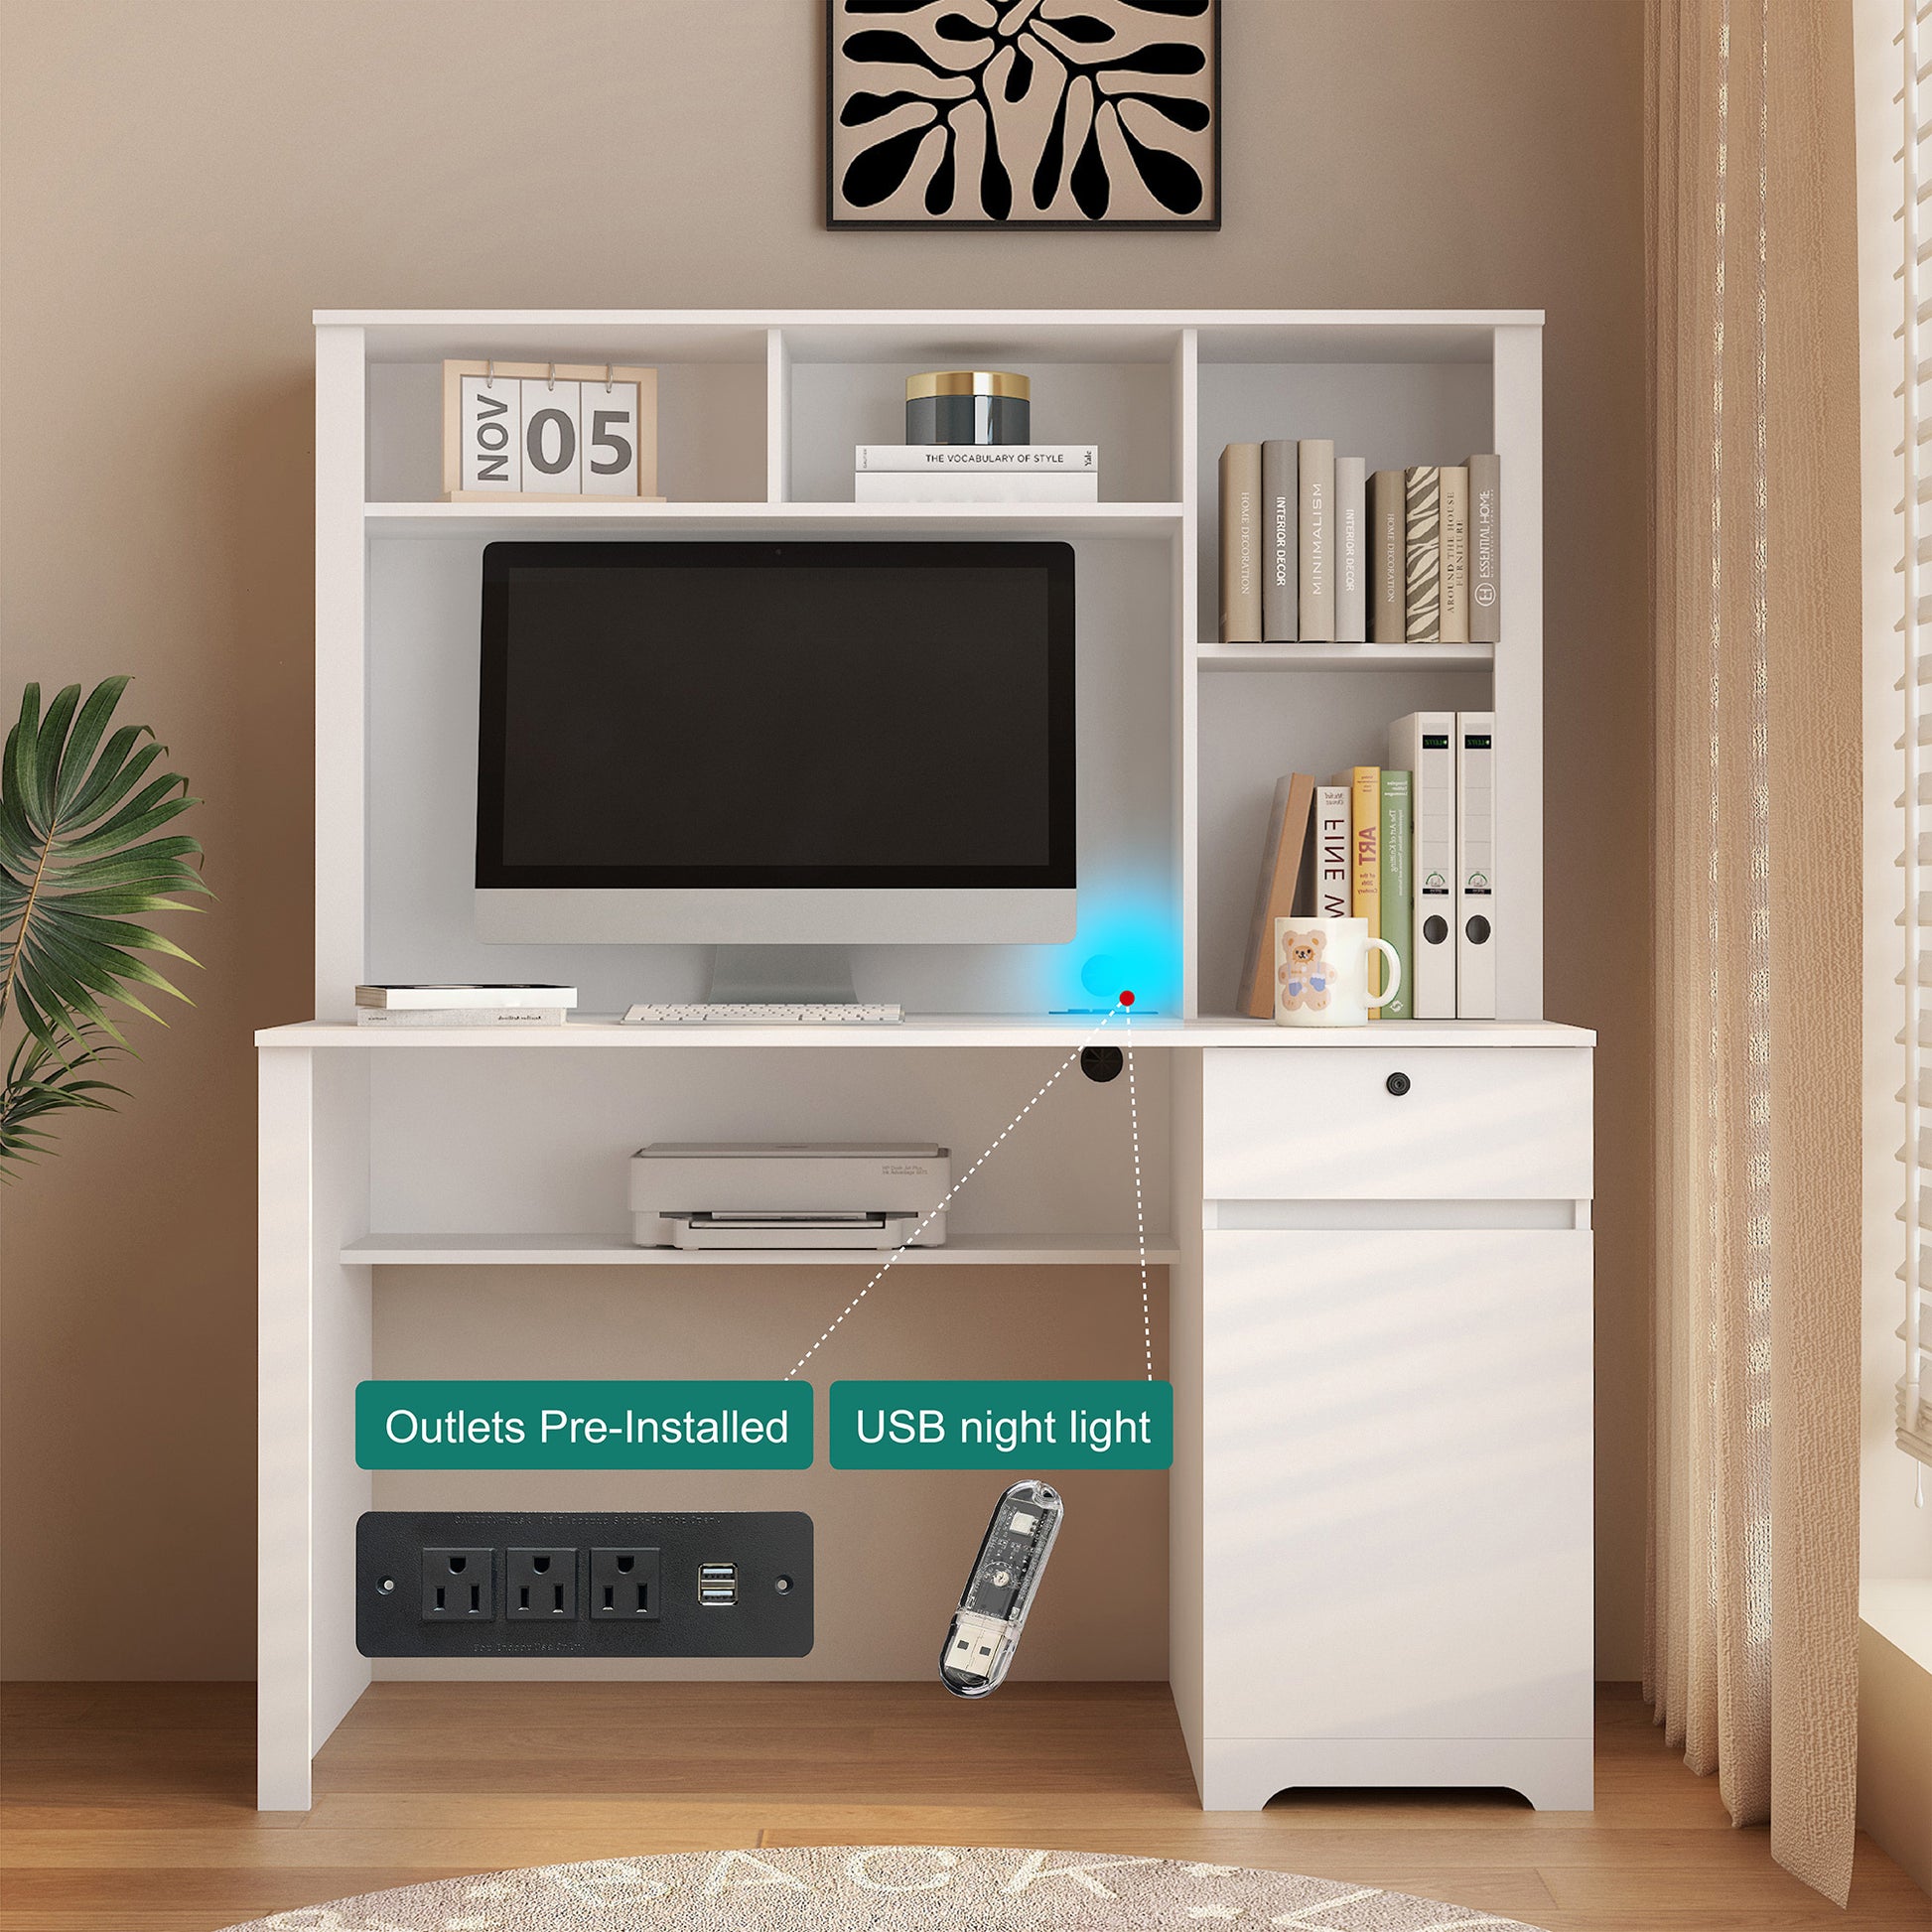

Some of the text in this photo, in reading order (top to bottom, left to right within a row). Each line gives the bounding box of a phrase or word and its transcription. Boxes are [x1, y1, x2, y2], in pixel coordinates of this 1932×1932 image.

[477, 394, 508, 482] NOV
[925, 454, 1064, 464] THE VOCABULARY OF STYLE
[1241, 491, 1250, 596] HOME DECORATION
[1277, 496, 1286, 587] INTERIOR DECOR
[1312, 483, 1322, 595] MINIMALISM
[1480, 489, 1489, 523] HOME
[1345, 508, 1354, 592] INTERIOR DECOR
[1480, 524, 1489, 578] ESSENTIAL
